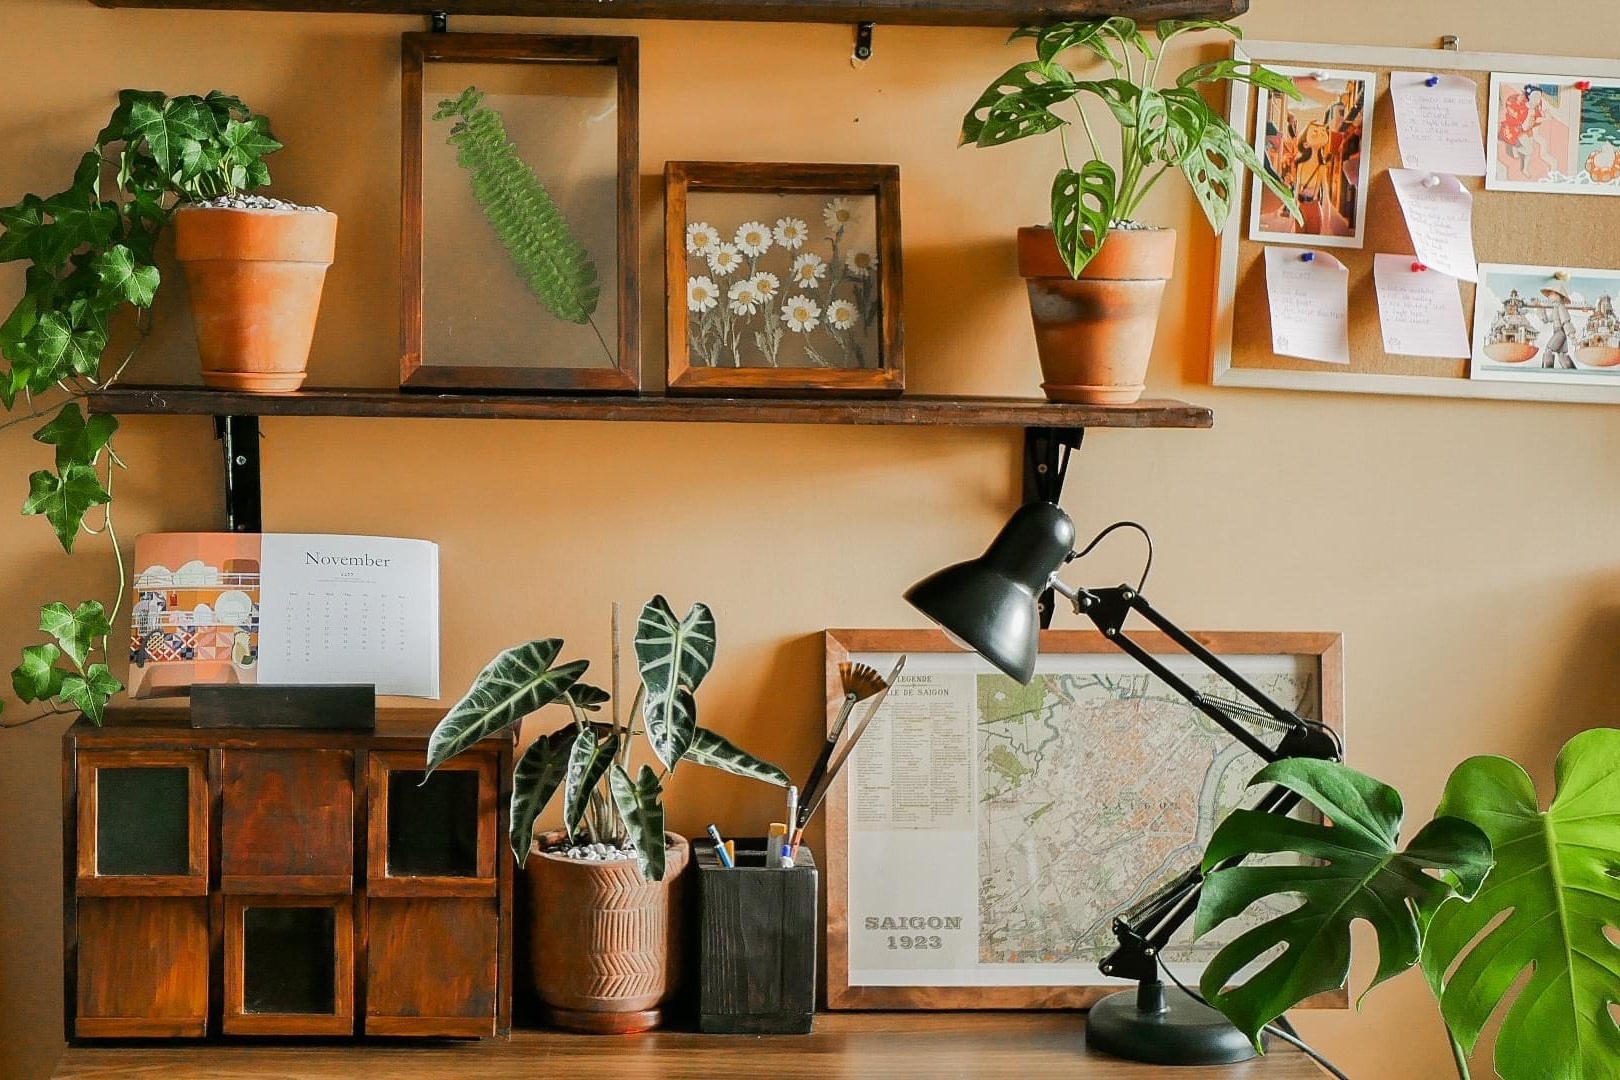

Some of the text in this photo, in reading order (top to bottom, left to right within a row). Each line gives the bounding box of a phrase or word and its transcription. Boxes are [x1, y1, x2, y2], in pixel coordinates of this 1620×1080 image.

[304, 551, 391, 567] November
[918, 688, 949, 696] SAIGON
[865, 916, 963, 930] SAIGON
[887, 935, 943, 950] 1923
